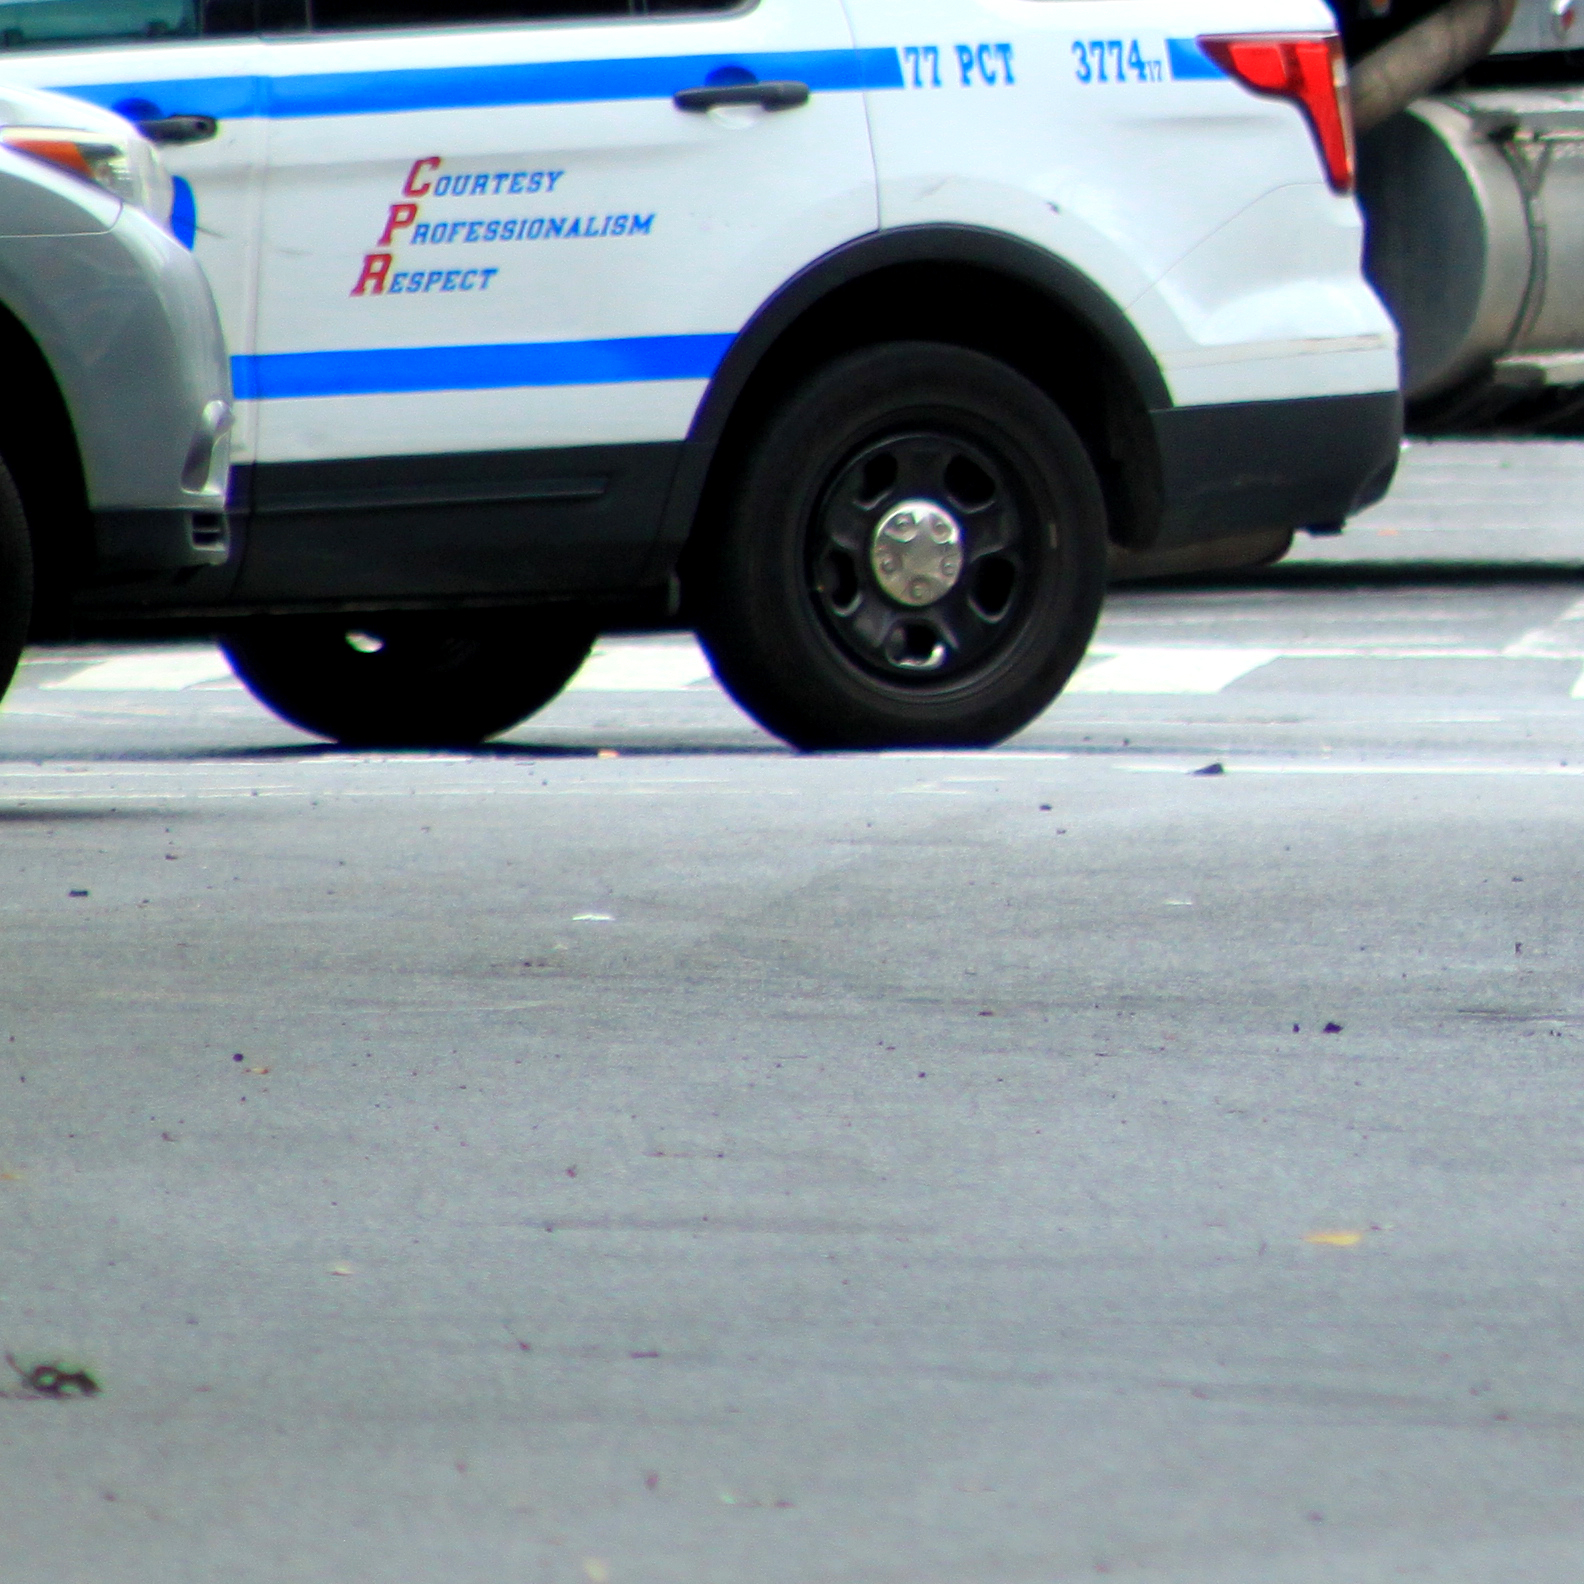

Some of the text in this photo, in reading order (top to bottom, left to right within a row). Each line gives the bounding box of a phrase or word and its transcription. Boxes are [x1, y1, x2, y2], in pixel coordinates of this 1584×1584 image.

[903, 45, 942, 90] 77
[954, 42, 1015, 88] PCT
[1071, 38, 1148, 84] 3774
[403, 156, 566, 198] COURTESY
[377, 203, 657, 247] PROFESSIONALISM
[350, 253, 499, 297] RESPECT
